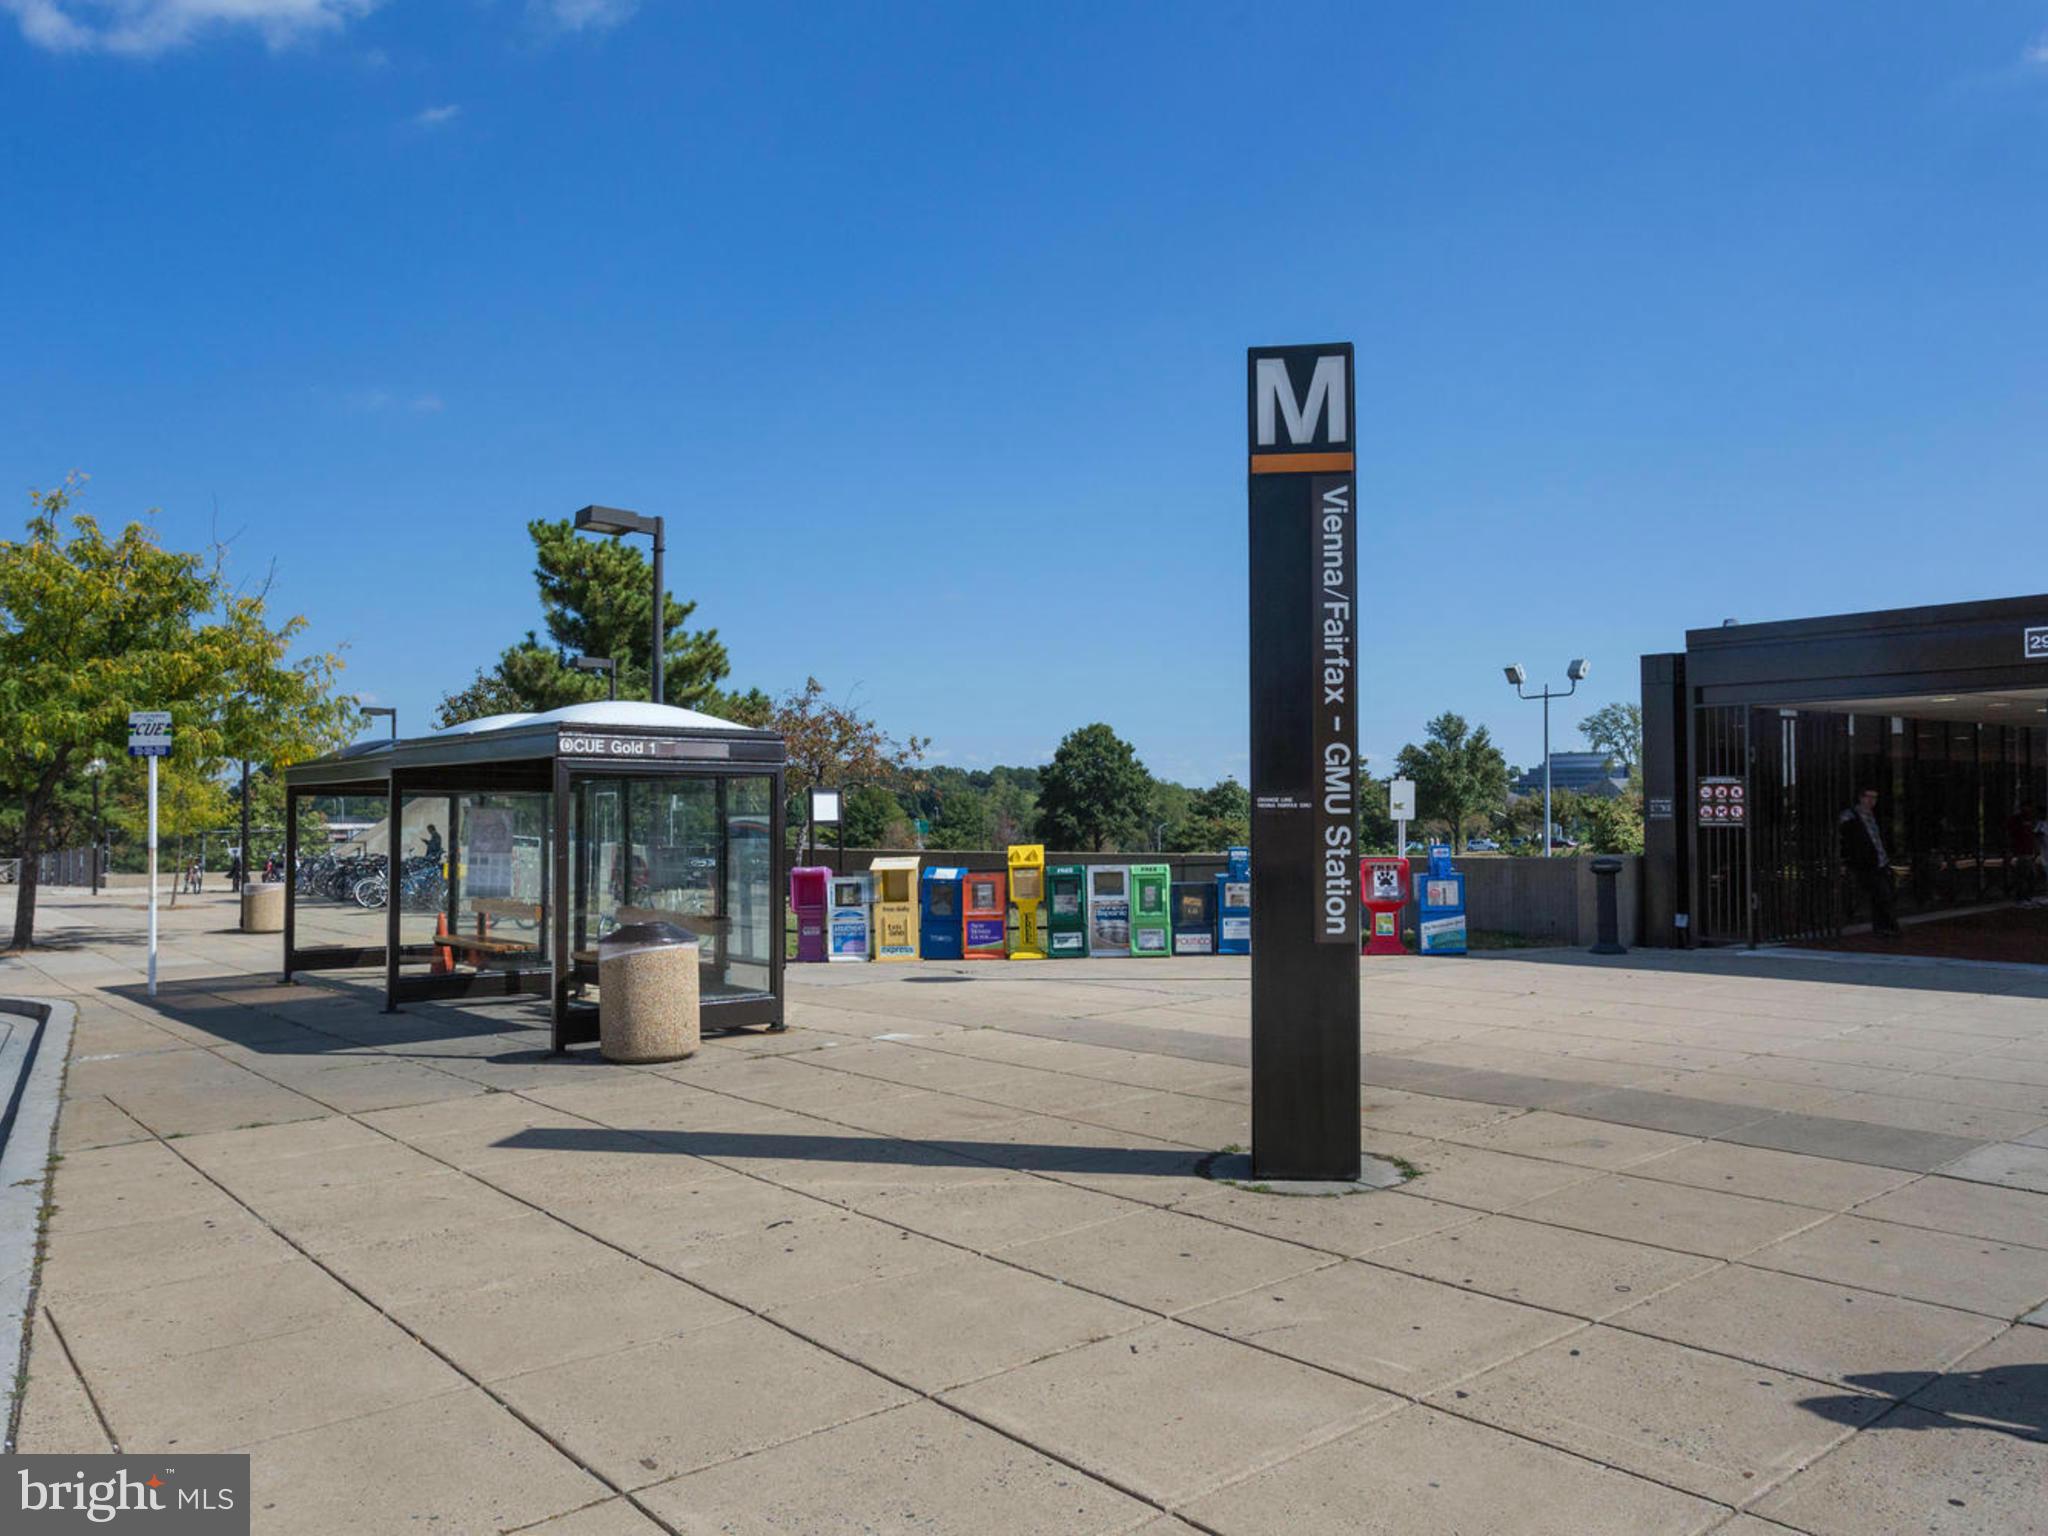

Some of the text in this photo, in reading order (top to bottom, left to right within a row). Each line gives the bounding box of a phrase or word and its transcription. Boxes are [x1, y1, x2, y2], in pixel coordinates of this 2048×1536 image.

[1257, 355, 1346, 446] M
[1322, 485, 1350, 704] Vienna/Fairfax
[135, 722, 165, 736] CUE
[574, 738, 656, 755] CUE Gold 1
[1324, 743, 1351, 814] GMU
[1325, 826, 1352, 934] Station
